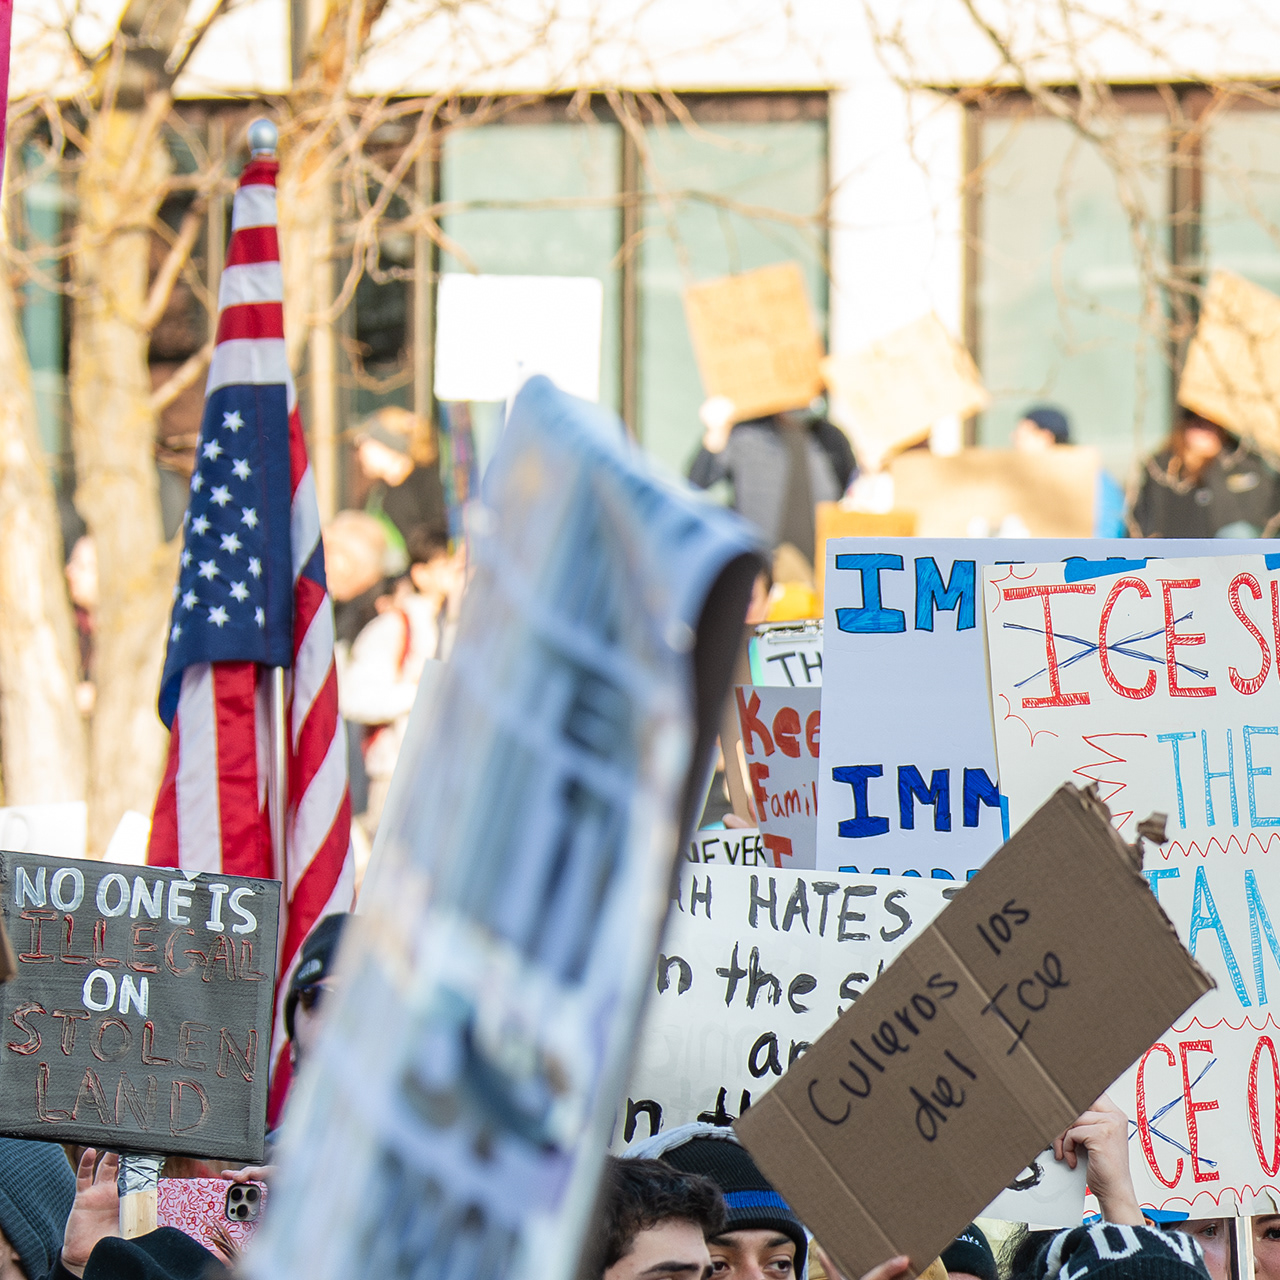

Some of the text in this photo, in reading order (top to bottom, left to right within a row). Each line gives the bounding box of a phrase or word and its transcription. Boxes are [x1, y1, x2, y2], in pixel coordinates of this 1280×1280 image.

[1003, 575, 1217, 708] ICE
[15, 867, 258, 934] NO ONE IS
[749, 875, 913, 942] HATES
[976, 899, 1032, 960] los
[18, 909, 268, 982] ILLEGAL
[716, 942, 818, 1014] the
[83, 969, 148, 1019] ON
[7, 1001, 258, 1082] STOLEN
[36, 1062, 210, 1137] LAND
[1136, 1040, 1221, 1188] CE
